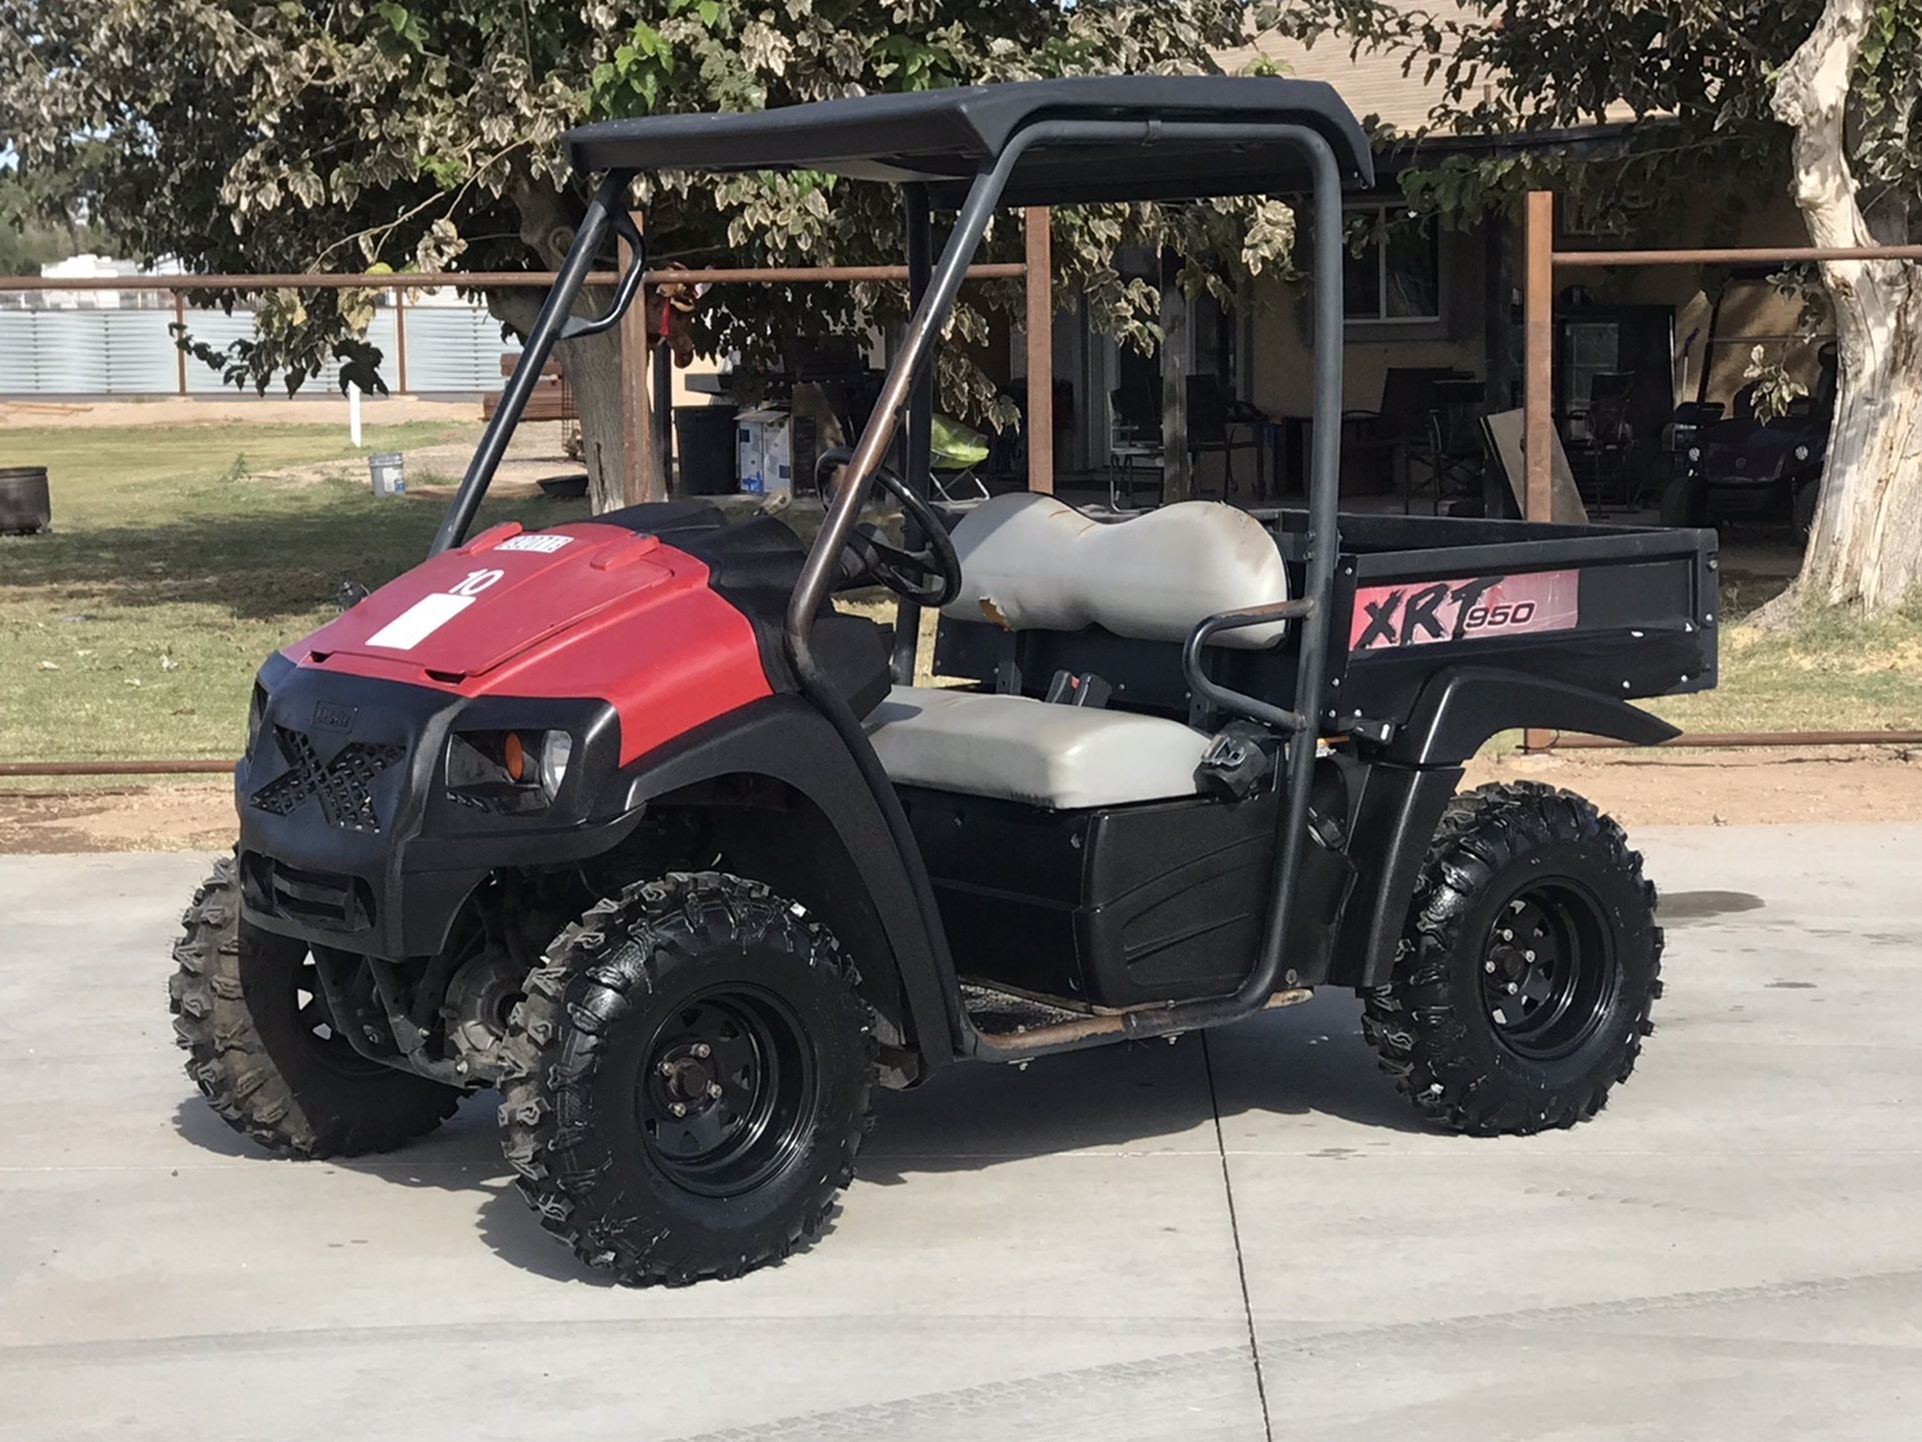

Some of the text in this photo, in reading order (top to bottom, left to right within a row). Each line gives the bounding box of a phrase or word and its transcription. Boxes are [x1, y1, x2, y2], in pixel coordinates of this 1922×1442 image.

[449, 568, 504, 595] 10
[1353, 576, 1536, 652] XRT 950
